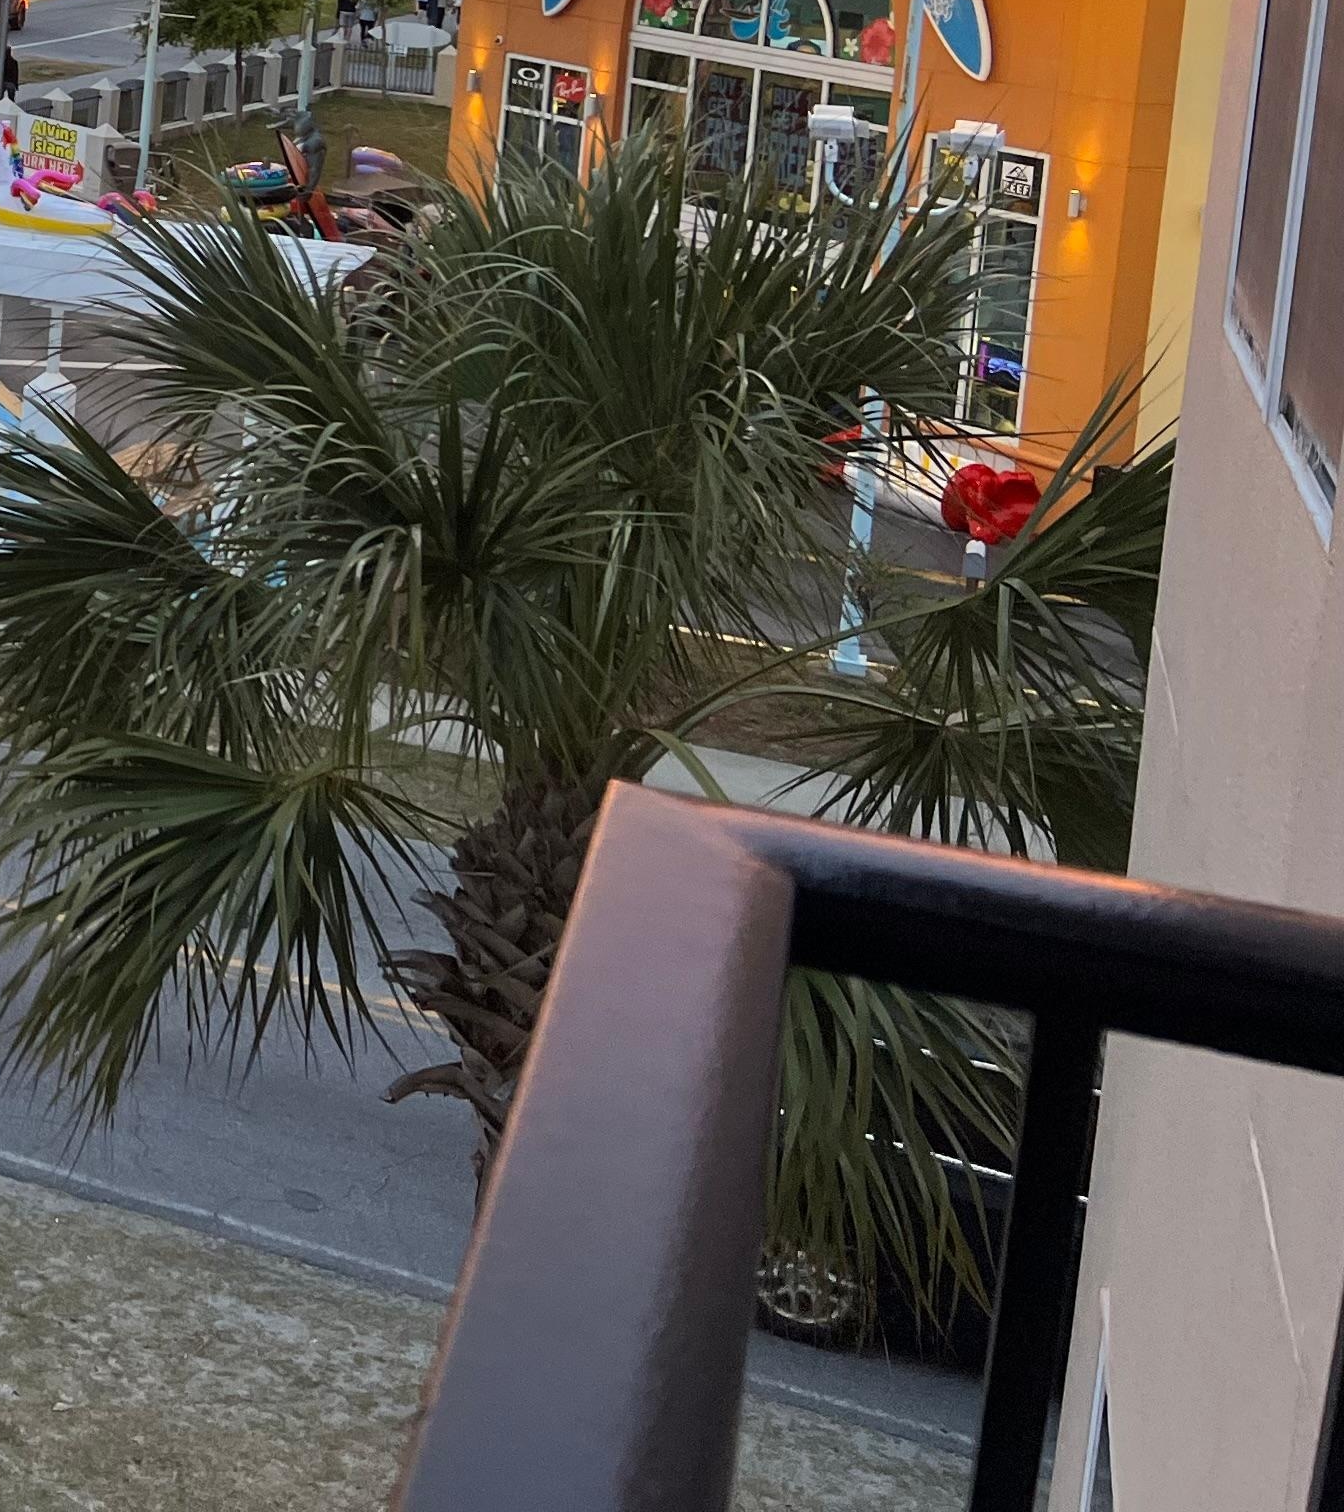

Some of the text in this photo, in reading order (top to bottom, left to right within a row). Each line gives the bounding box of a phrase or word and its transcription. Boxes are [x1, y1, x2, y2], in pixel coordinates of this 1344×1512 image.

[31, 119, 78, 144] Alvins
[48, 159, 77, 176] HERE
[1001, 180, 1031, 197] REEF
